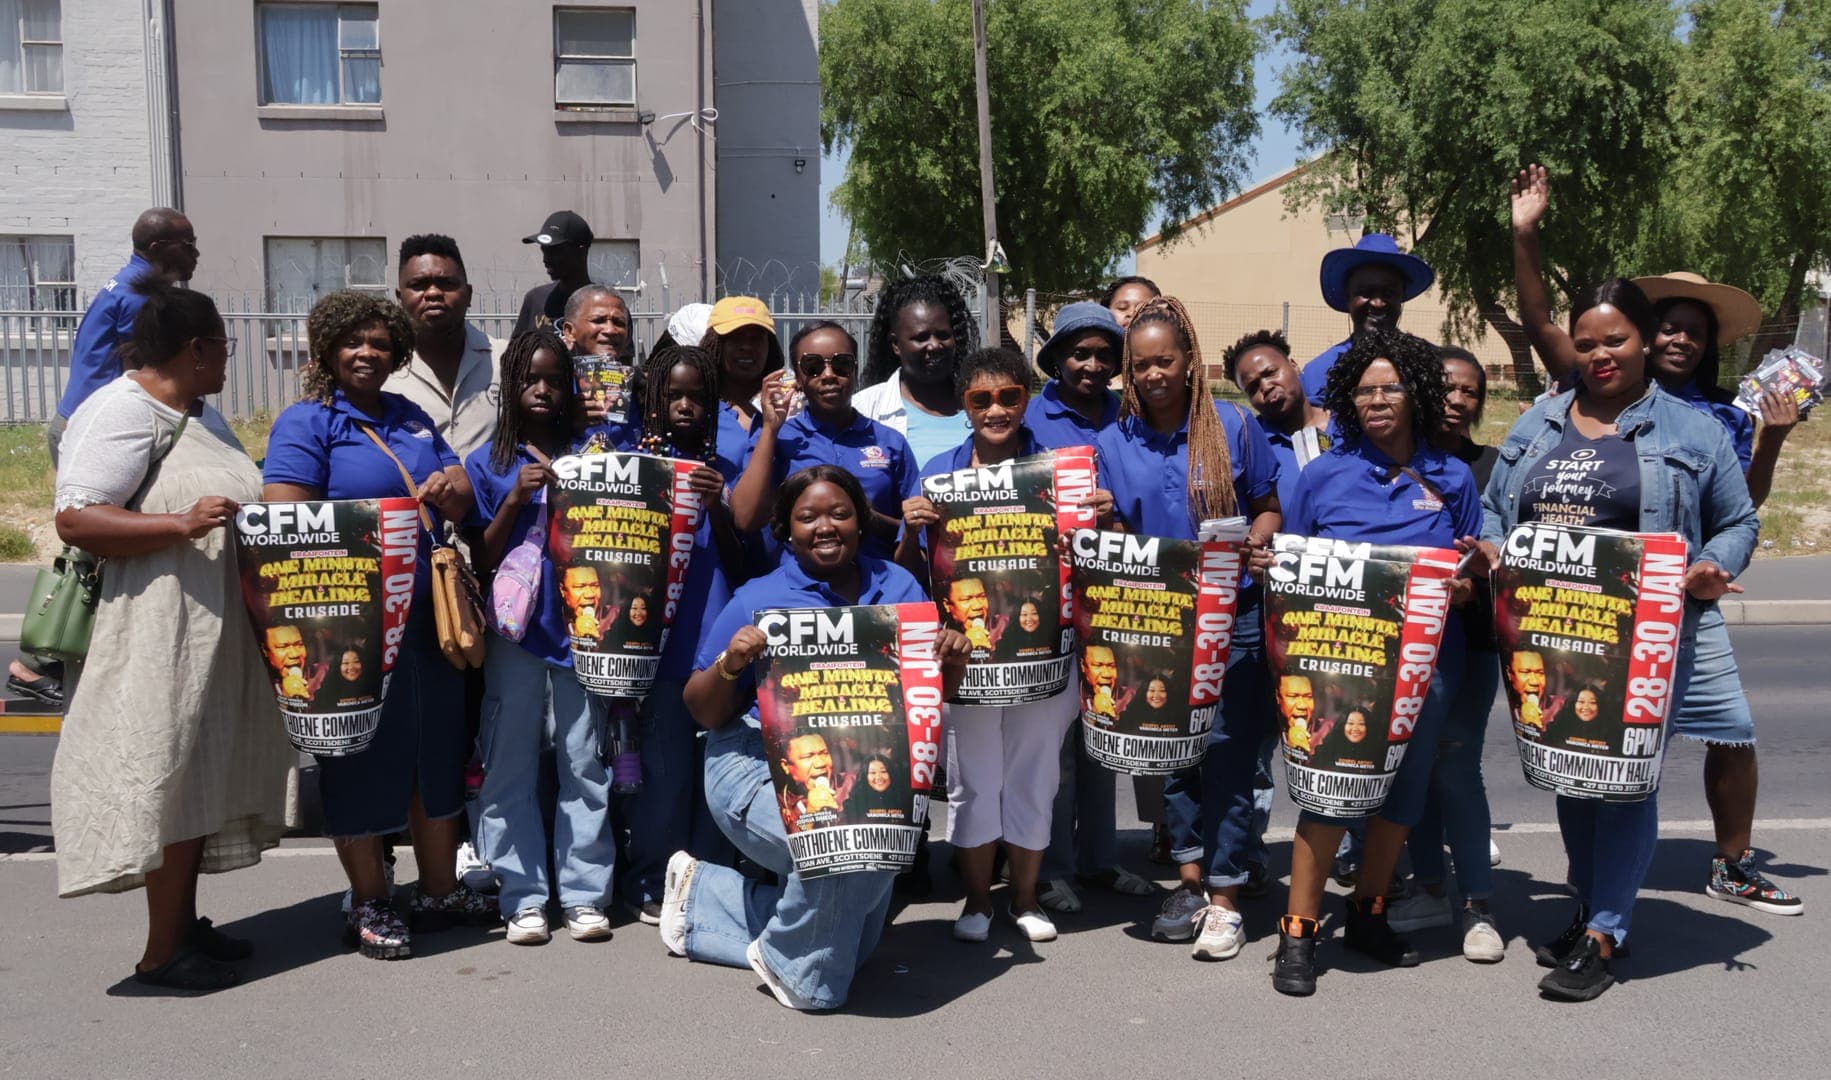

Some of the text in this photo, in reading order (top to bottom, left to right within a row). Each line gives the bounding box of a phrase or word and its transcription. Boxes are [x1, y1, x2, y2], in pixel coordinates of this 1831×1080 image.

[1545, 460, 1605, 471] START
[924, 463, 1015, 493] CFM
[1556, 471, 1587, 484] your
[928, 489, 1018, 503] WORLDWIDE
[1540, 481, 1596, 501] journey
[236, 503, 336, 535] CFM
[567, 505, 670, 527] ONE MINUTE
[1532, 503, 1597, 517] FINANCIAL
[1541, 513, 1585, 526] HEALTH
[581, 520, 659, 538] MIRACLE
[946, 513, 1055, 533] ONE MINUTE
[240, 532, 341, 546] WORLDWIDE
[383, 510, 418, 564] JAN
[572, 534, 661, 554] HEALING
[962, 527, 1044, 544] MIRACLE
[954, 542, 1048, 561] HEALING
[1072, 528, 1160, 566] CFM
[1507, 527, 1597, 566] CFM
[259, 557, 380, 578] ONE MINUTE
[585, 550, 651, 565] CRUSADE
[968, 558, 1038, 572] CRUSADE
[1074, 556, 1160, 577] WORLDWIDE
[1505, 555, 1597, 578] WORLDWIDE
[1268, 552, 1365, 590] CFM
[278, 572, 367, 591] MIRACLE
[1270, 581, 1366, 601] WORLDWIDE
[269, 587, 371, 607] HEALING
[1085, 585, 1120, 600] ONE
[1123, 587, 1194, 610] MINUTE
[1407, 577, 1449, 635] JAN
[1515, 586, 1632, 617] ONE MINUTE
[285, 604, 360, 619] CRUSADE
[1099, 600, 1181, 620] MIRACLE
[1528, 602, 1617, 627] MIRACLE
[757, 612, 855, 647] CFM
[1090, 614, 1183, 636] HEALING
[1193, 551, 1240, 699] 28-30 JAN
[1282, 611, 1399, 639] ONE MINUTE
[1519, 616, 1620, 644] HEALING
[1061, 627, 1075, 654] 6P
[1102, 630, 1171, 648] CRUSADE
[1297, 626, 1385, 649] MIRACLE
[1531, 633, 1606, 656] CRUSADE
[1626, 553, 1685, 718] 28-30 JAN
[761, 643, 858, 659] WORLDWIDE
[1286, 642, 1386, 666] HEALING
[1003, 661, 1063, 687] COMMUNITY
[1300, 658, 1374, 678] CRUSADE
[590, 678, 633, 686] SCOTTSDENE
[781, 669, 899, 689] ONE MINUTE
[1392, 642, 1437, 736] 28-30
[799, 683, 888, 698] MIRACLE
[984, 687, 1030, 696] SCOTTSDENE
[792, 697, 893, 717] HEALING
[901, 621, 941, 784] 28-30 JAN
[808, 714, 883, 728] CRUSADE
[304, 739, 351, 747] SCOTTSDENE
[1123, 737, 1192, 761] COMMUNITY
[1622, 727, 1659, 756] 6PM
[1106, 756, 1150, 767] SCOTTSDENE
[1549, 751, 1625, 783] COMMUNITY
[1626, 761, 1649, 783] HALL
[1317, 773, 1385, 801] COMMUNITY
[1534, 770, 1575, 786] SCOTTSDENE
[1300, 792, 1345, 807] SCOTTSDENE
[853, 826, 915, 851] COMMUNITY
[816, 857, 833, 867] AVE,
[835, 852, 883, 864] SCOTTSDENE
